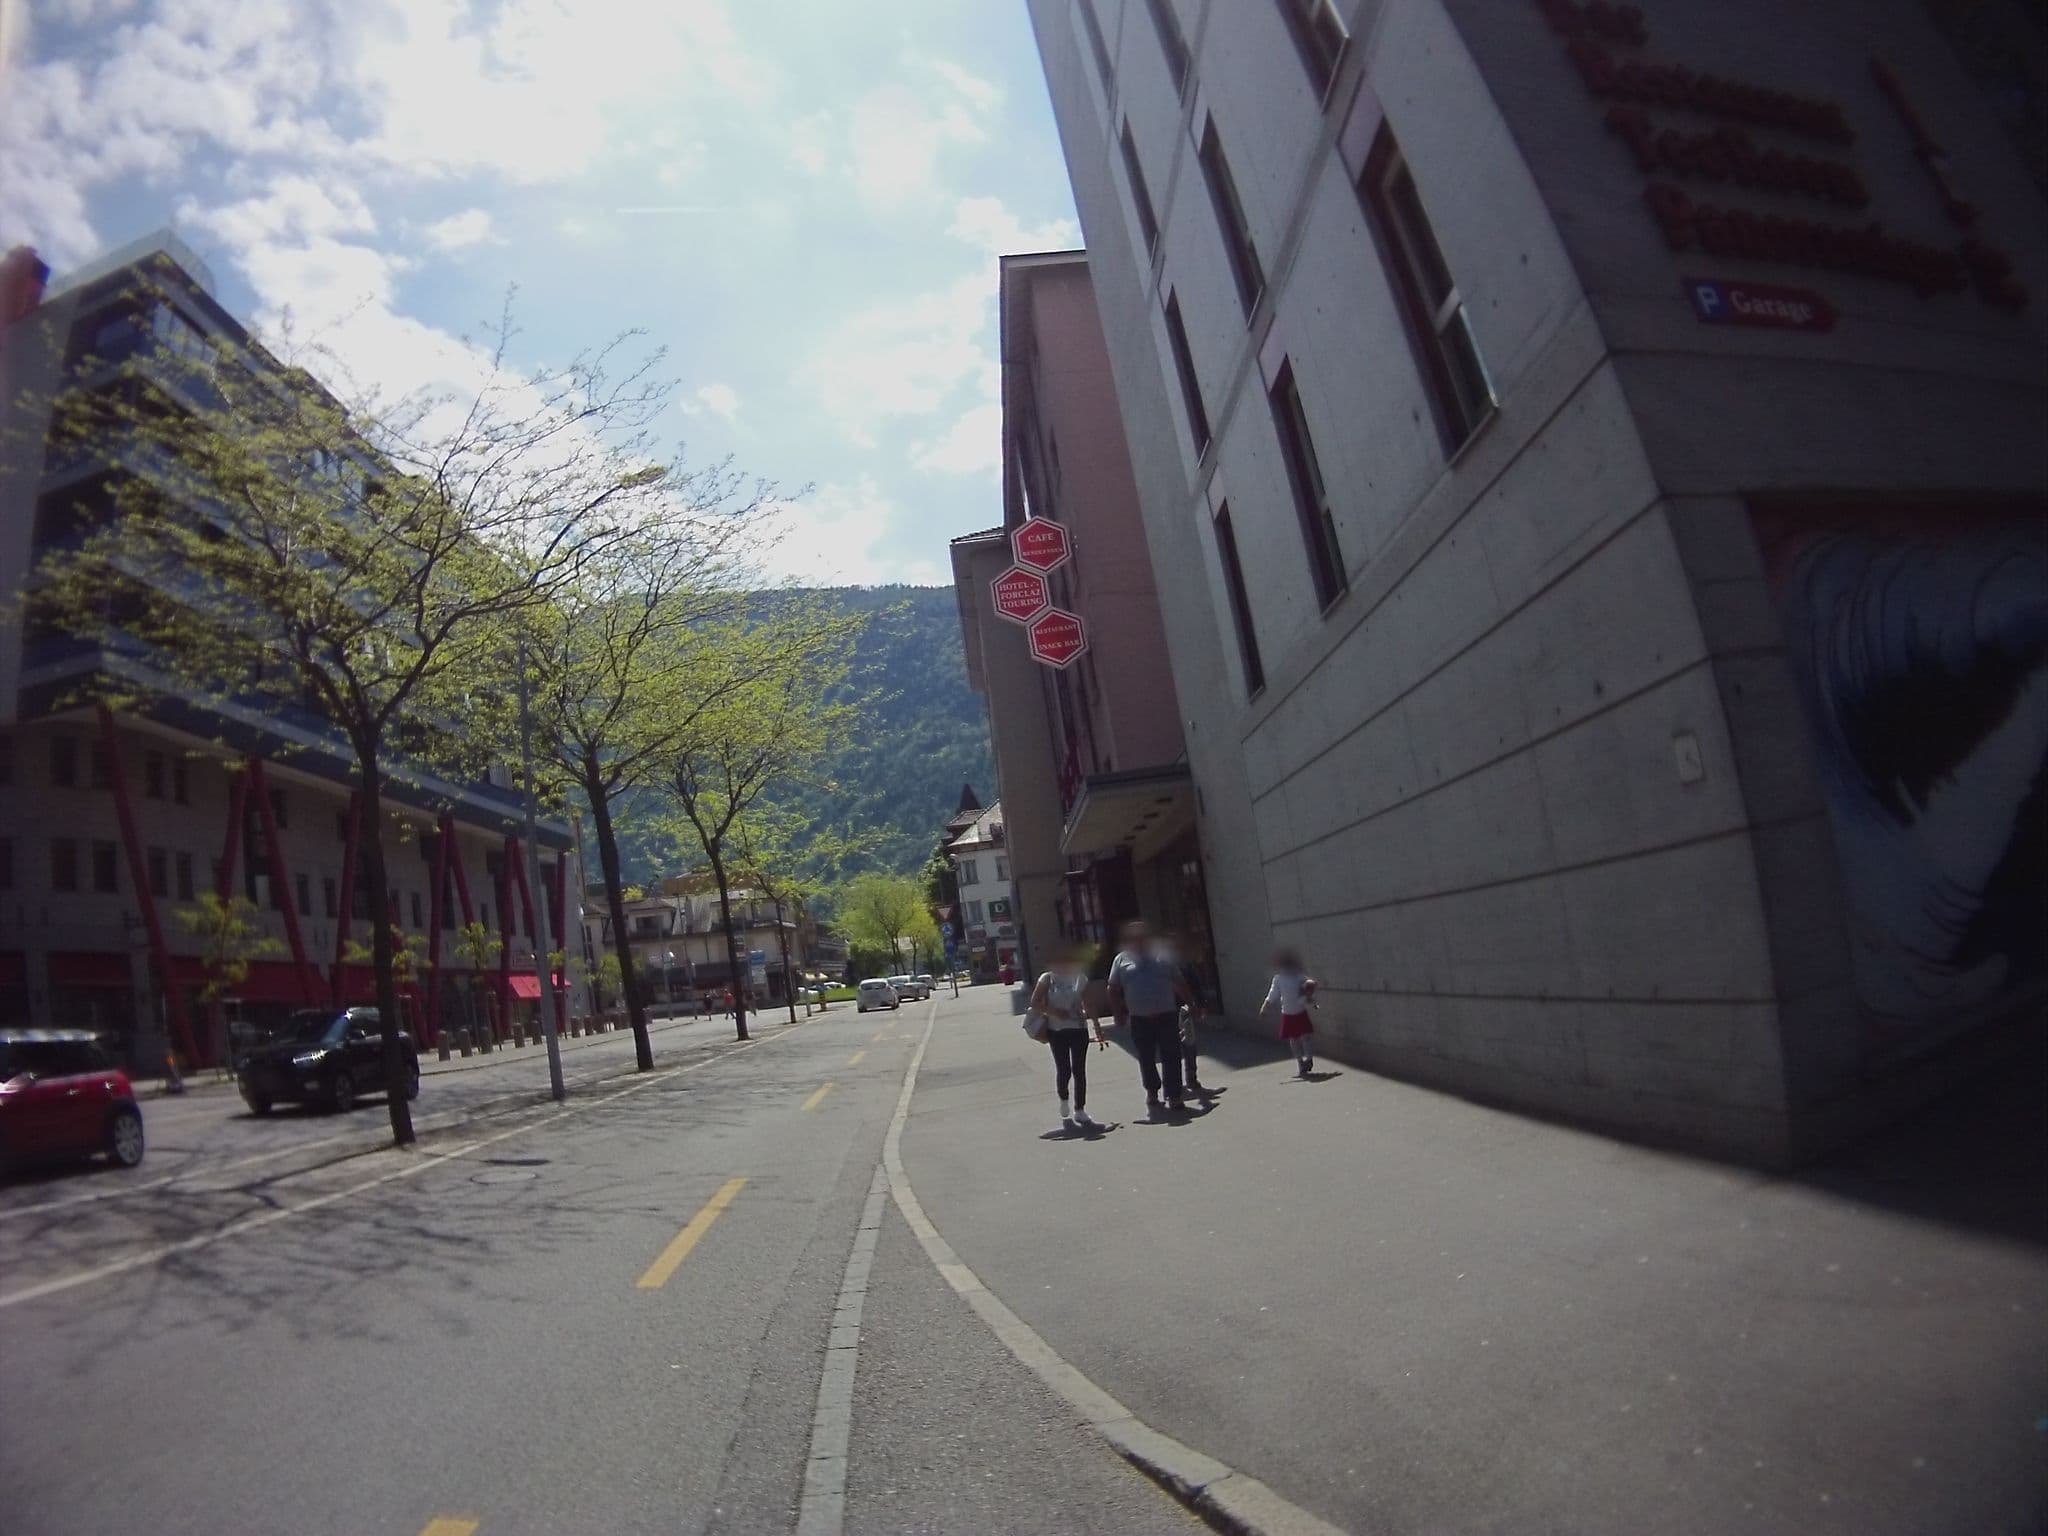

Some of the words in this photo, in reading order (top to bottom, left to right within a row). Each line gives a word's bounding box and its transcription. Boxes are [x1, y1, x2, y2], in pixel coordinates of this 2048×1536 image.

[1696, 285, 1719, 314] P
[1730, 289, 1815, 323] Garage
[999, 582, 1030, 591] HOTEL
[1000, 589, 1041, 600] FORCLAZ
[1001, 597, 1044, 609] TOURING
